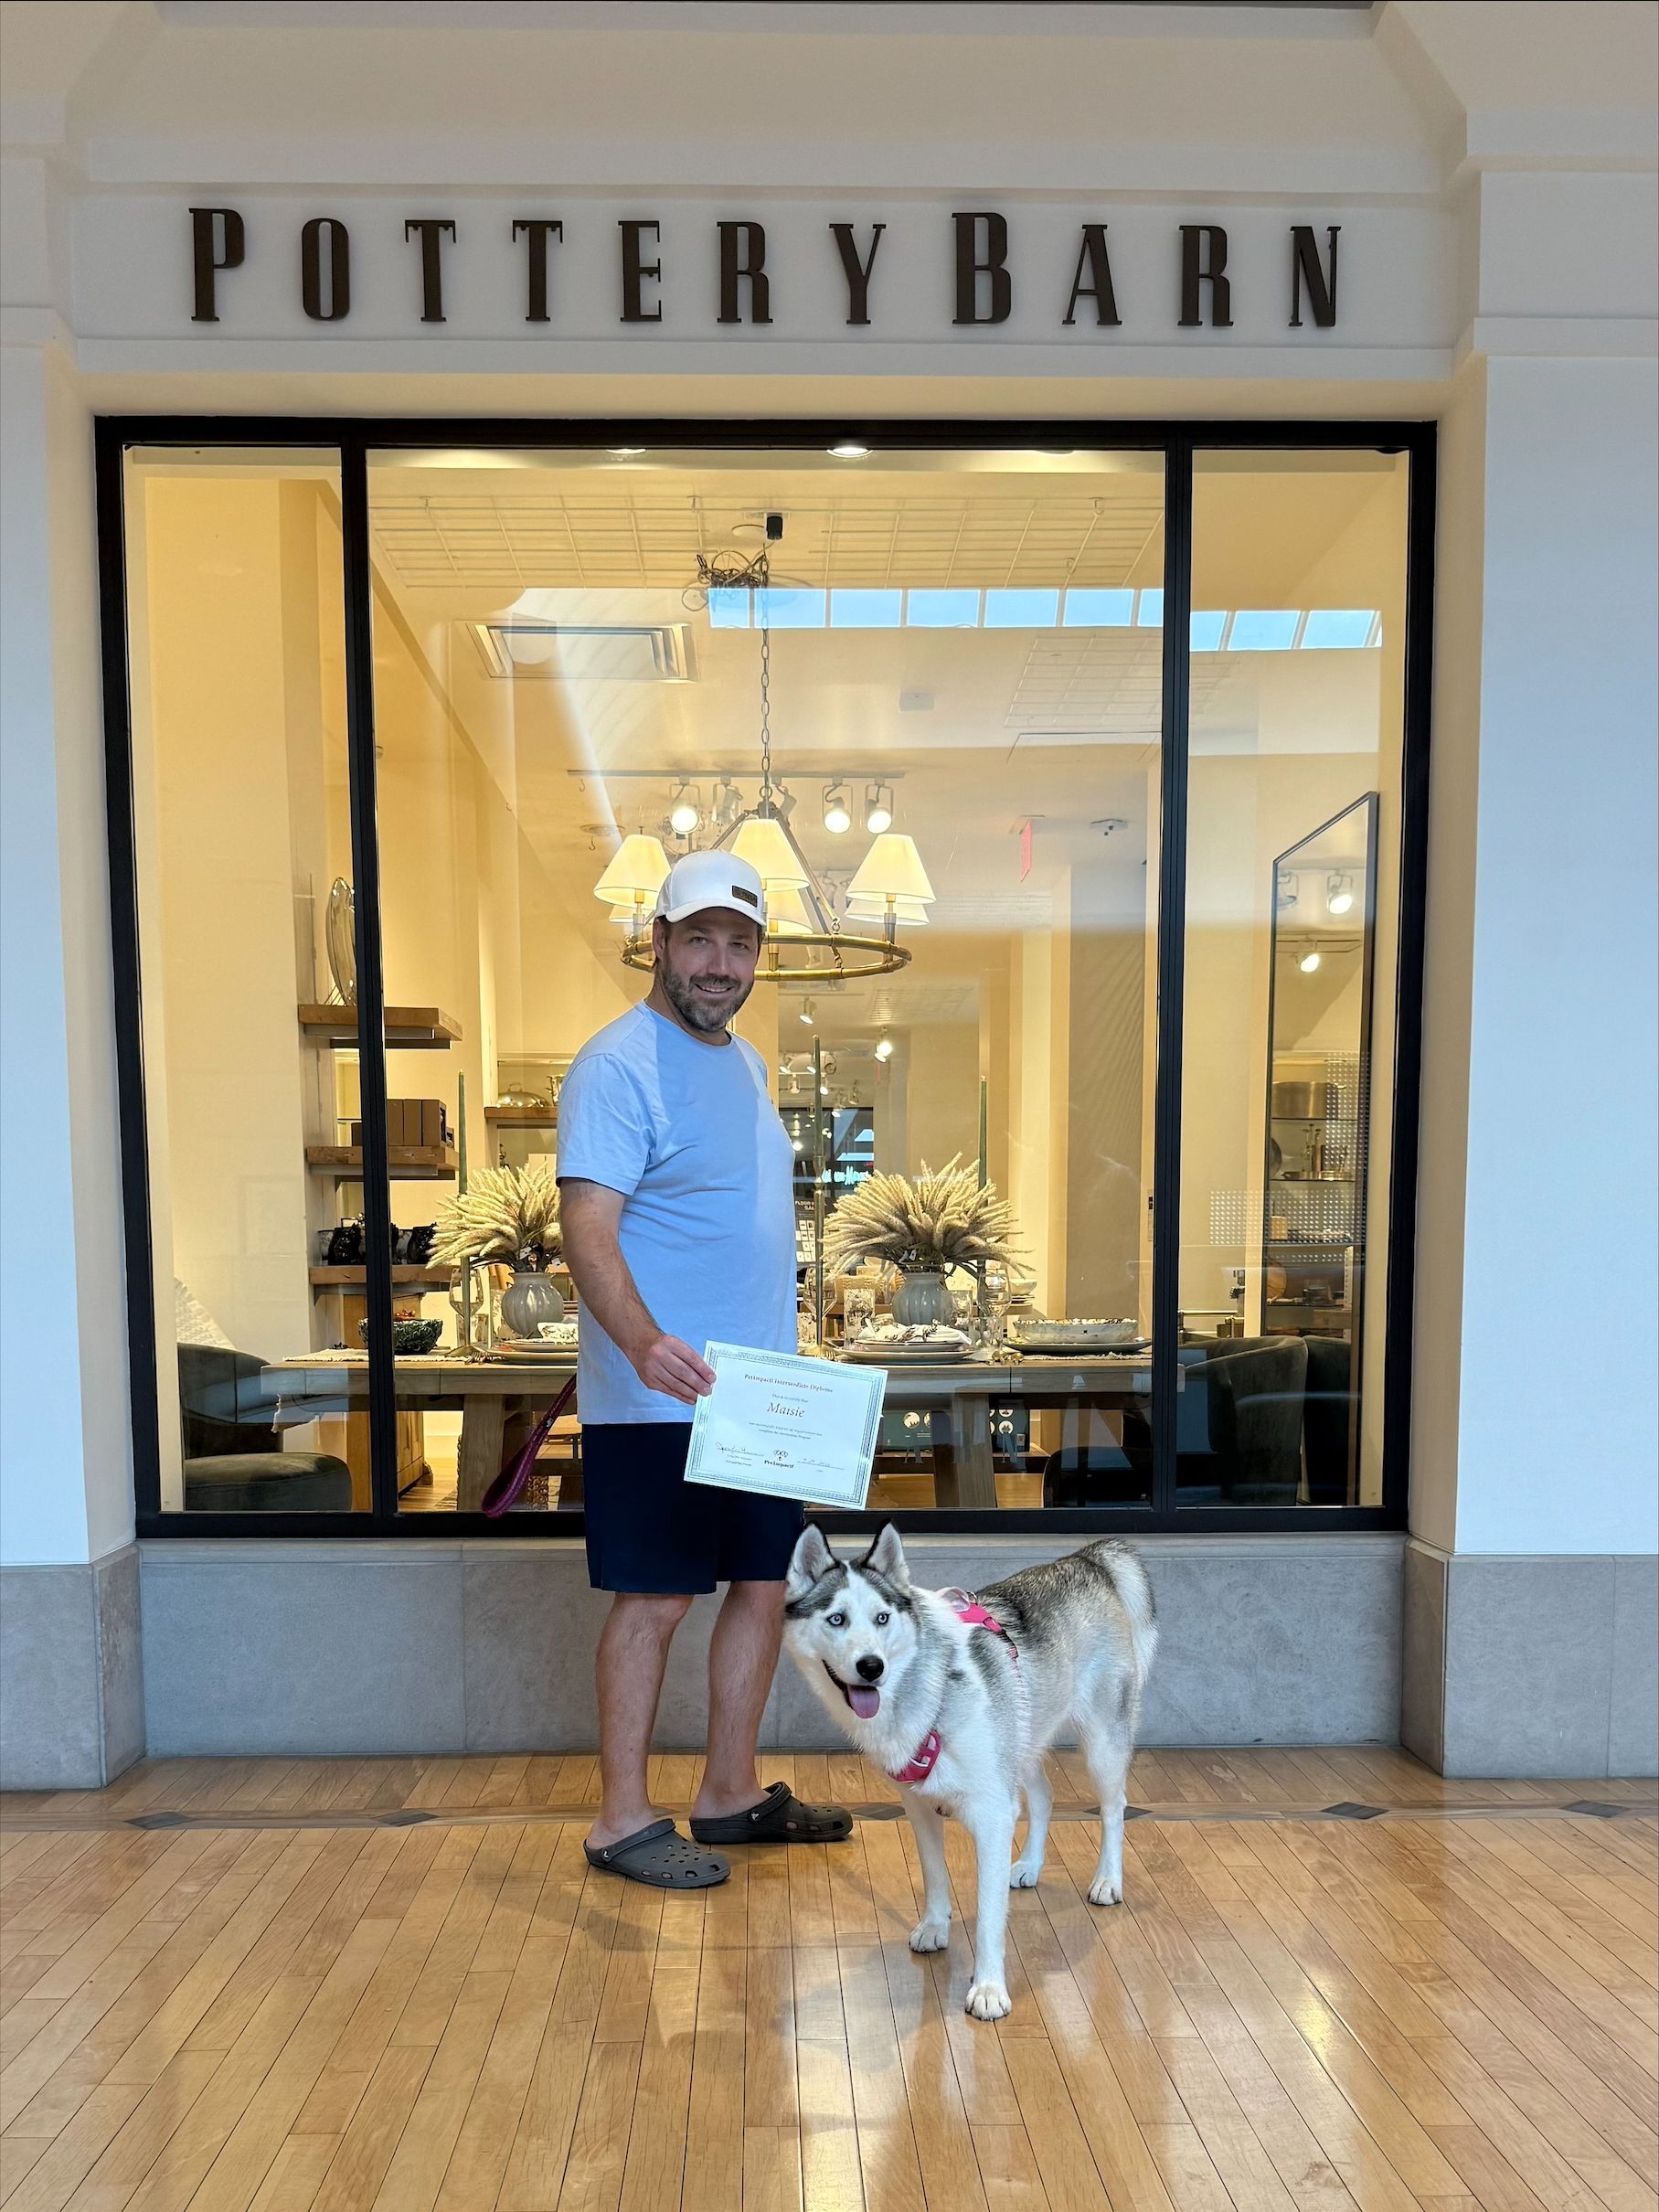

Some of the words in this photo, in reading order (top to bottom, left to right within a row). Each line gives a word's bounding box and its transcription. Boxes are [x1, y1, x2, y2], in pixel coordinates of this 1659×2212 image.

[188, 207, 887, 325] POTTERY
[951, 211, 1342, 328] BARN
[767, 1402, 805, 1418] Maisie
